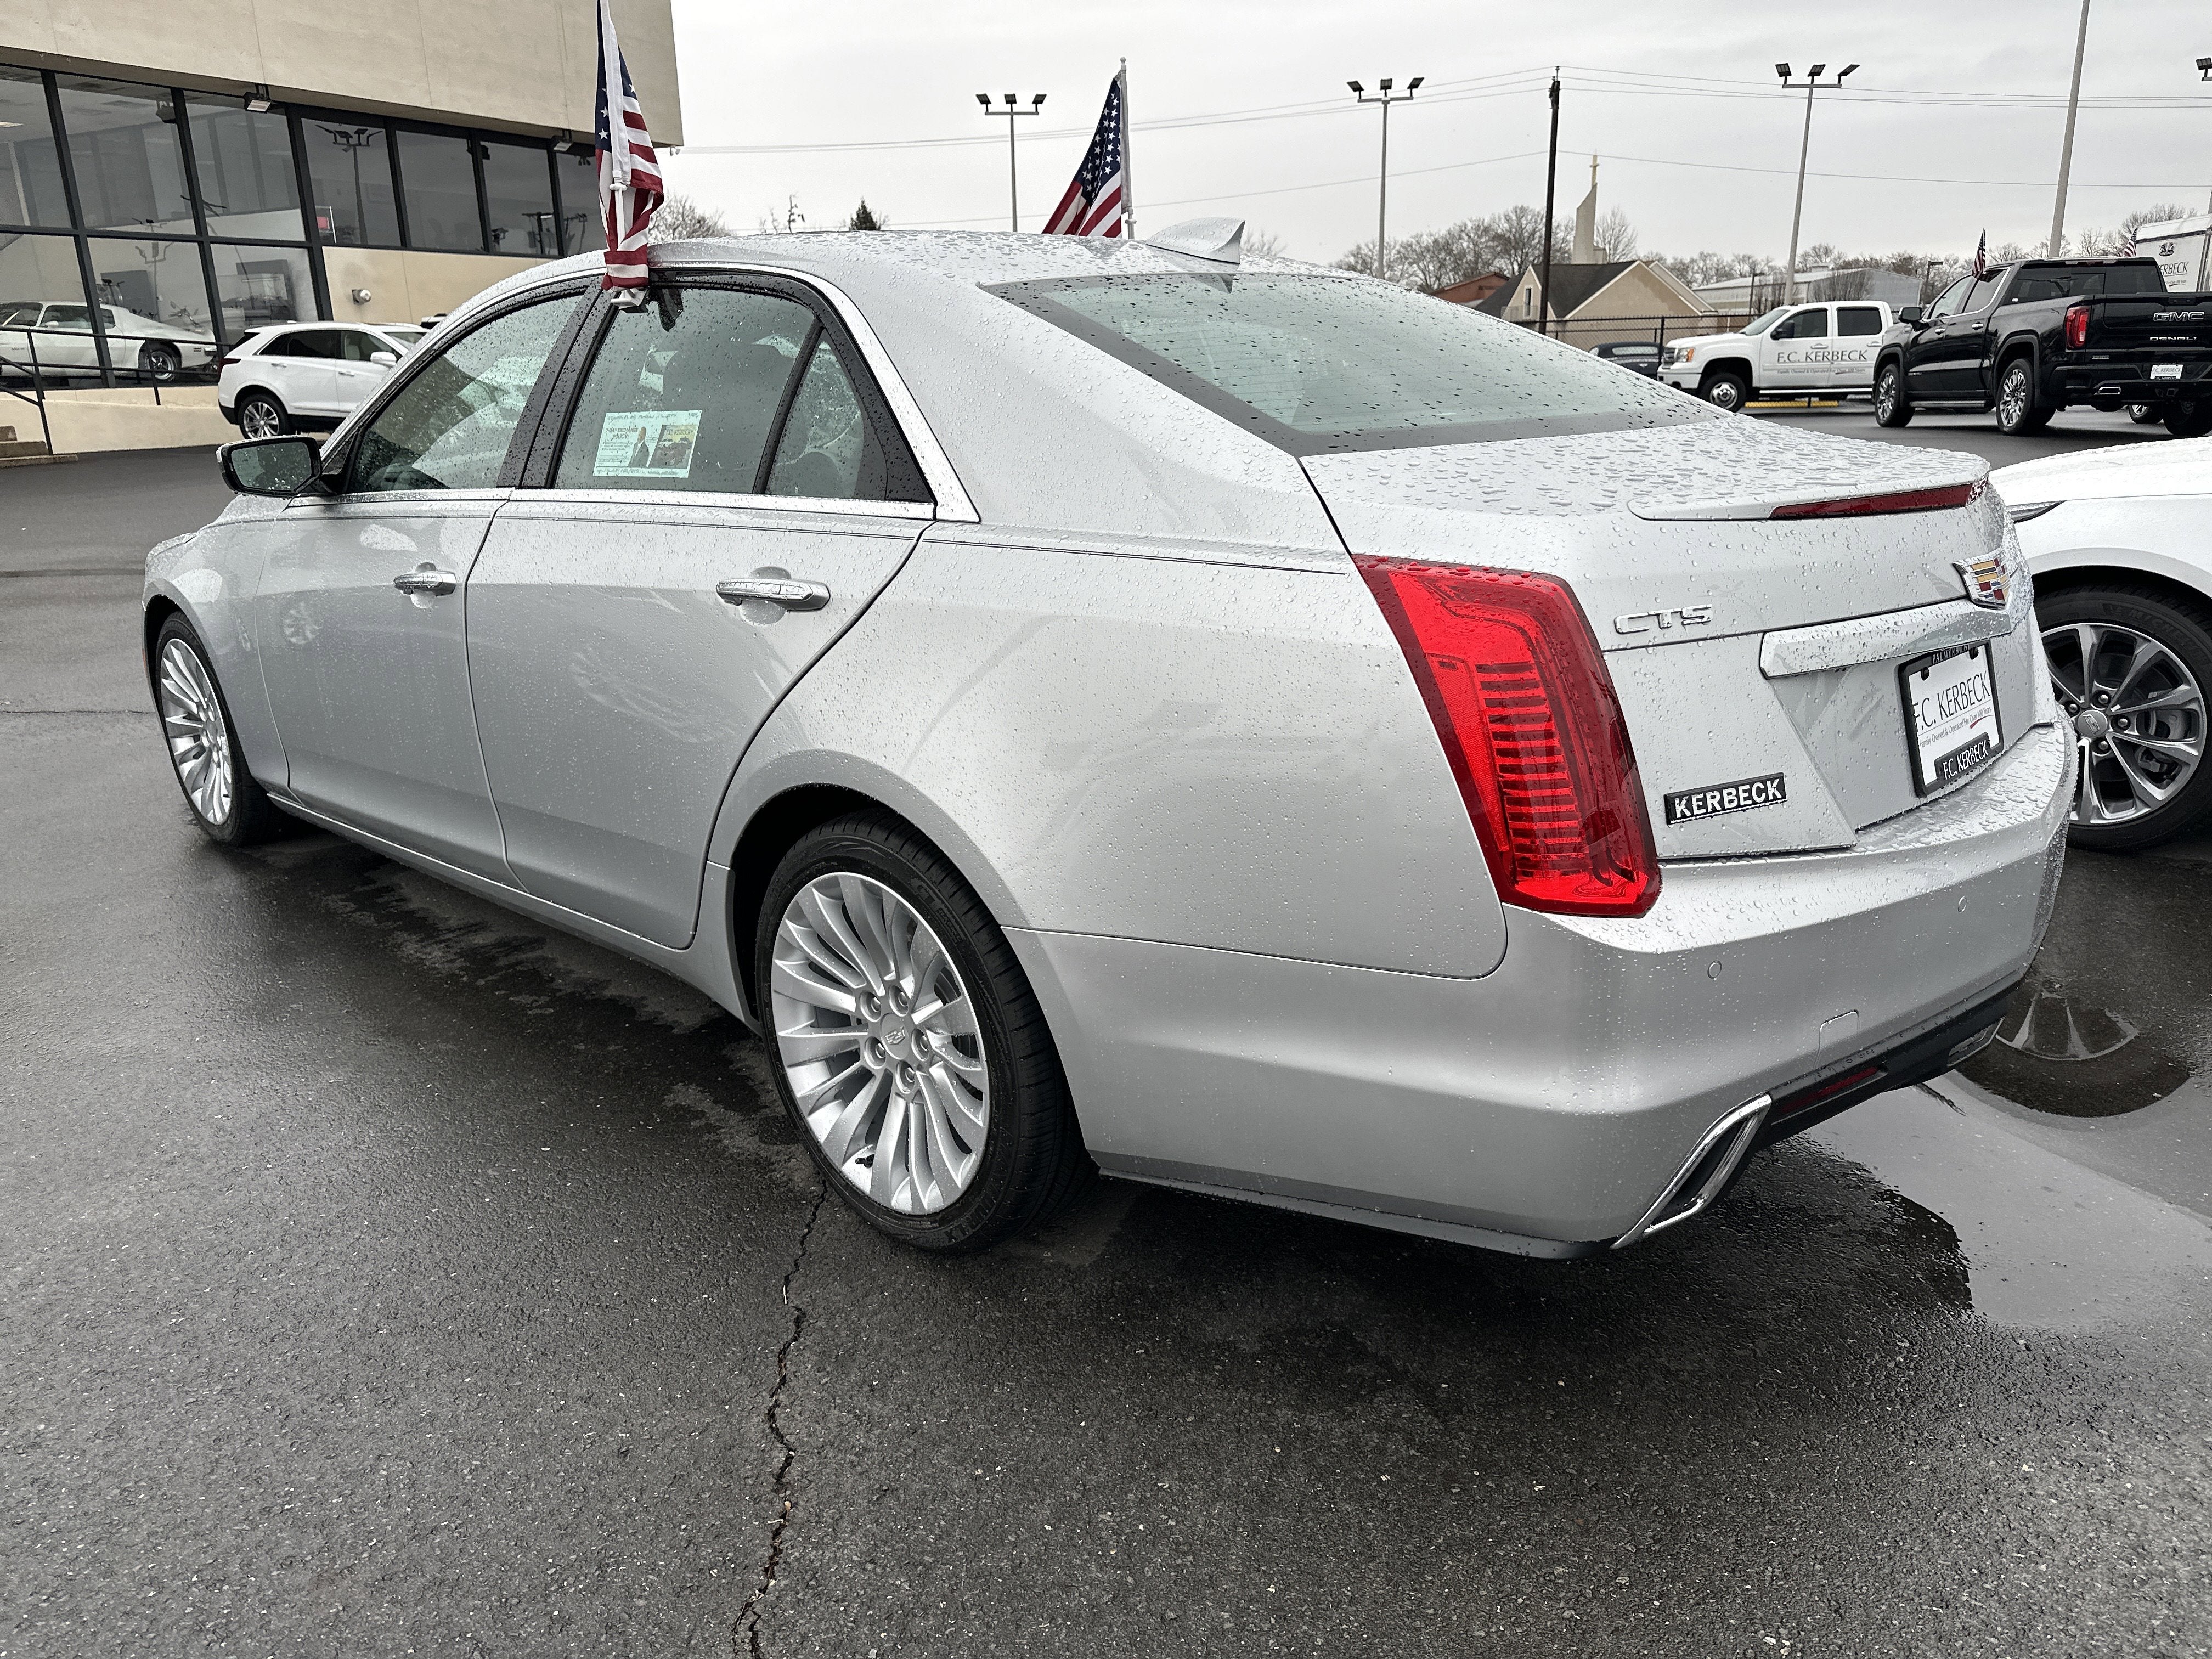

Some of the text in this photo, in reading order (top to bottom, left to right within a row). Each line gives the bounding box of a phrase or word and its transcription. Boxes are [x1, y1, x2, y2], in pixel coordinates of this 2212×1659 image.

[2159, 262, 2189, 275] ERBECK
[2153, 312, 2204, 321] GMC
[1778, 349, 1867, 362] F.C. KERBECK
[1614, 604, 1713, 634] CTS
[1937, 671, 1990, 721] KERBECK
[1920, 736, 1931, 749] Family
[1932, 728, 1945, 742] Owned
[1945, 727, 1948, 736] &
[1949, 718, 1963, 735] Operated
[1983, 707, 1991, 715] Years
[1943, 740, 1989, 780] F.C. KERBECK
[1674, 778, 1782, 819] KERBECK
